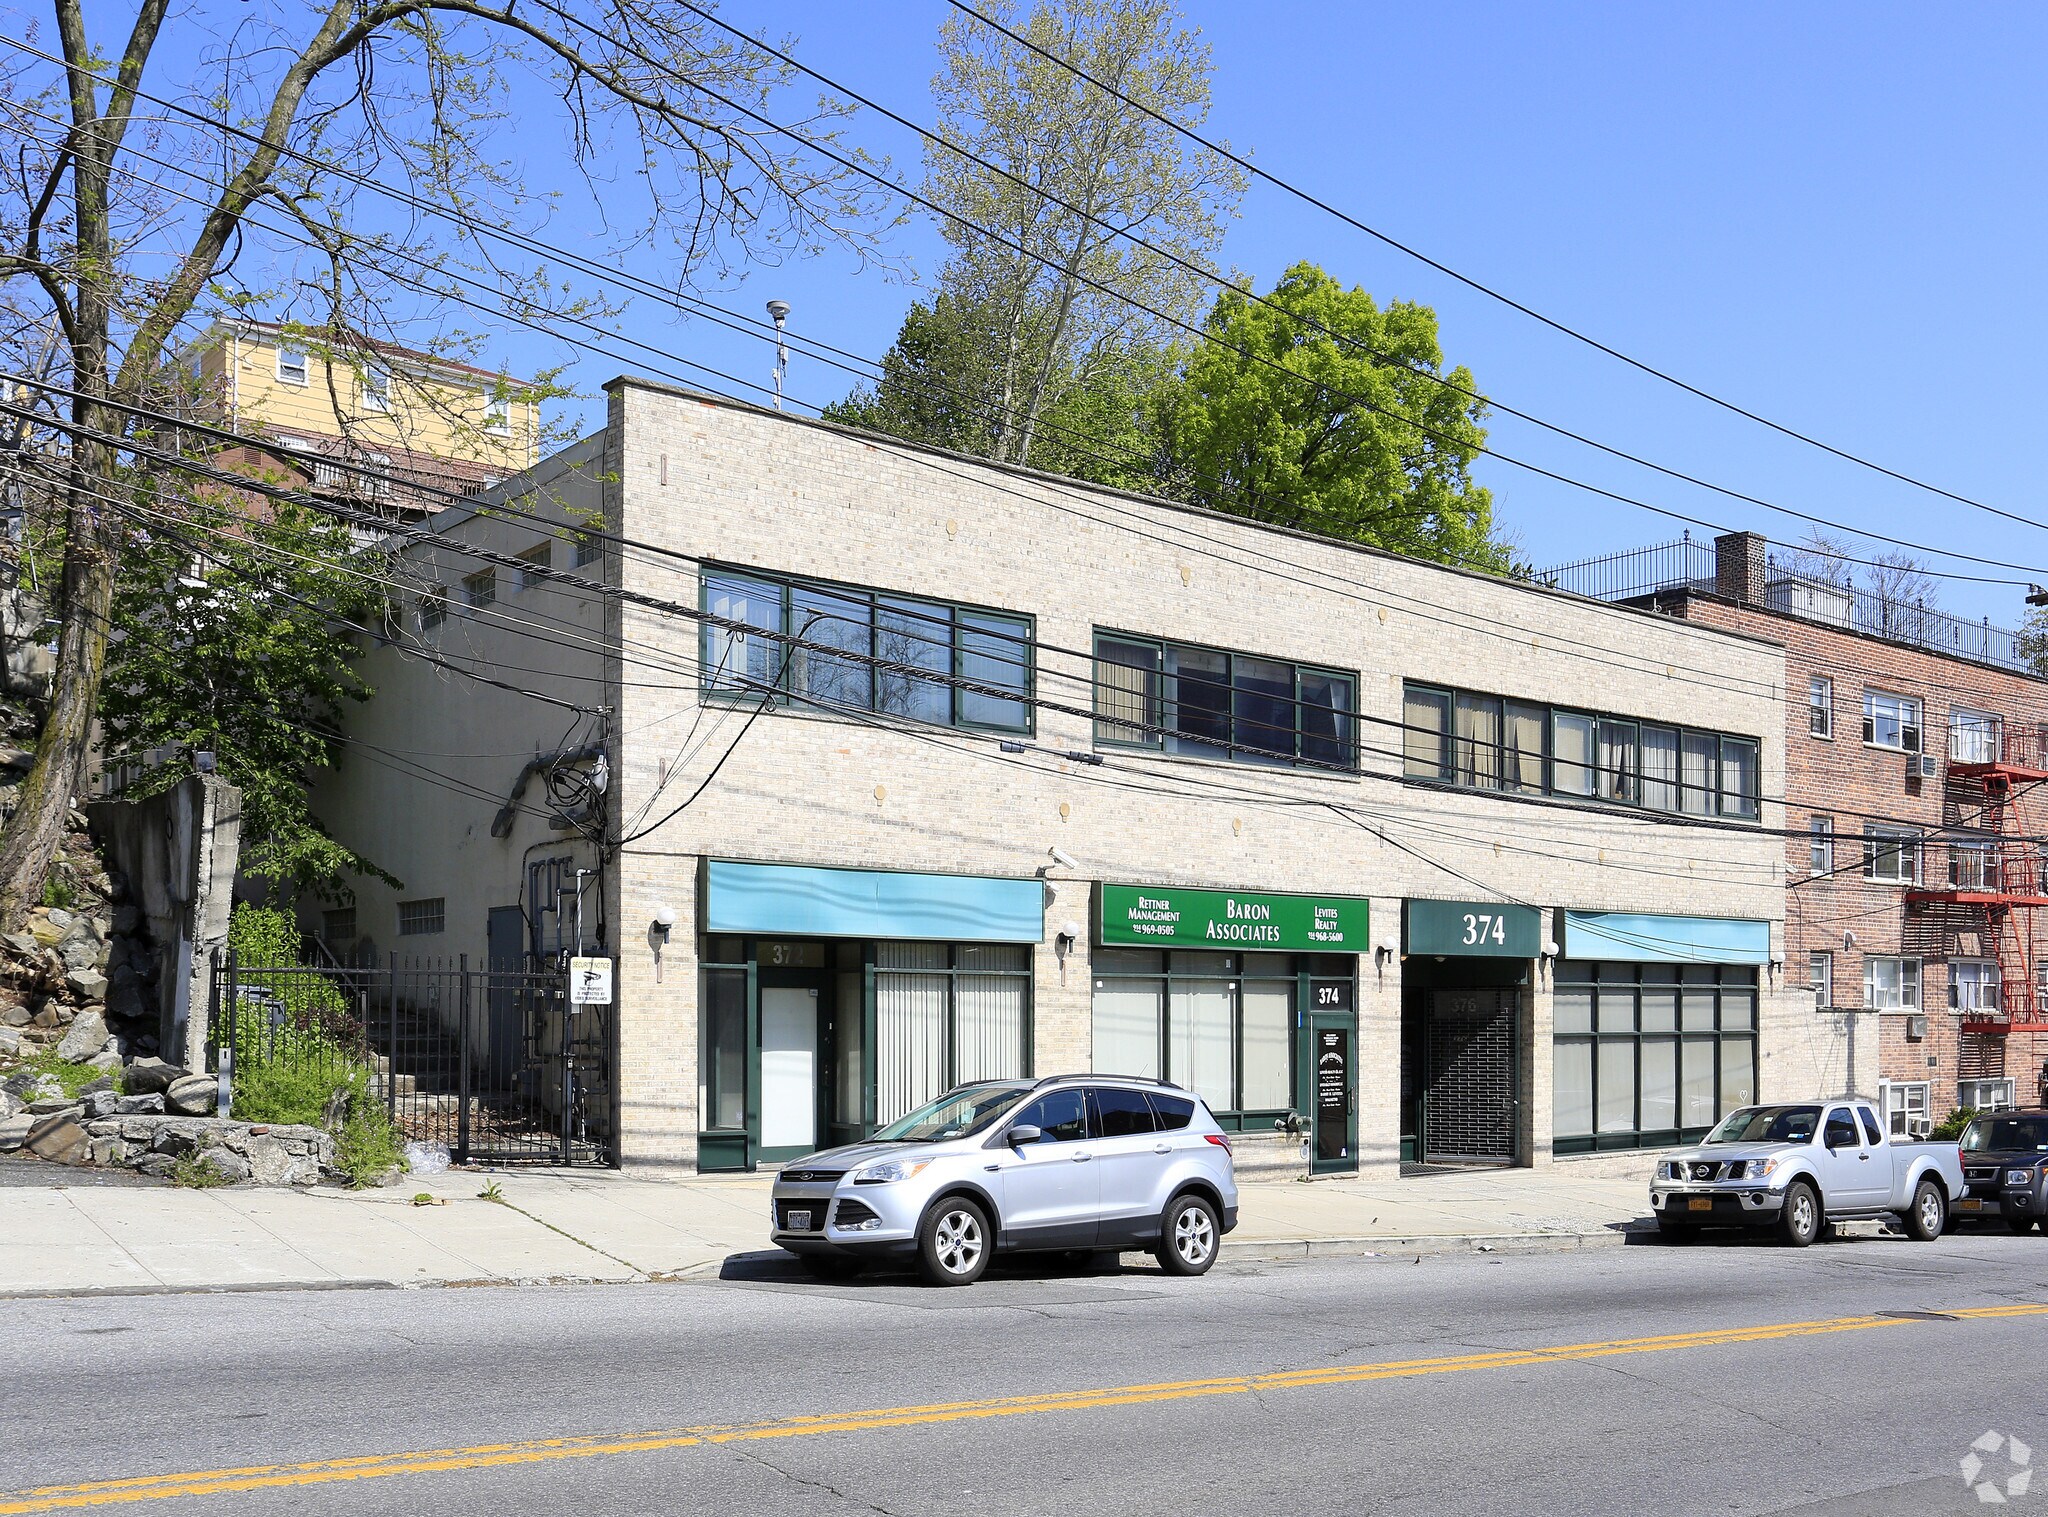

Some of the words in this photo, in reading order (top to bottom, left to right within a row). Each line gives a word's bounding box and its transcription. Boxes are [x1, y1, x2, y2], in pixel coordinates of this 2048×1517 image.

[1227, 899, 1270, 920] BARON
[1142, 924, 1174, 935] 969-0505
[1206, 919, 1280, 941] ASSOCIATES
[1462, 914, 1506, 945] 374
[1319, 987, 1339, 1004] 374
